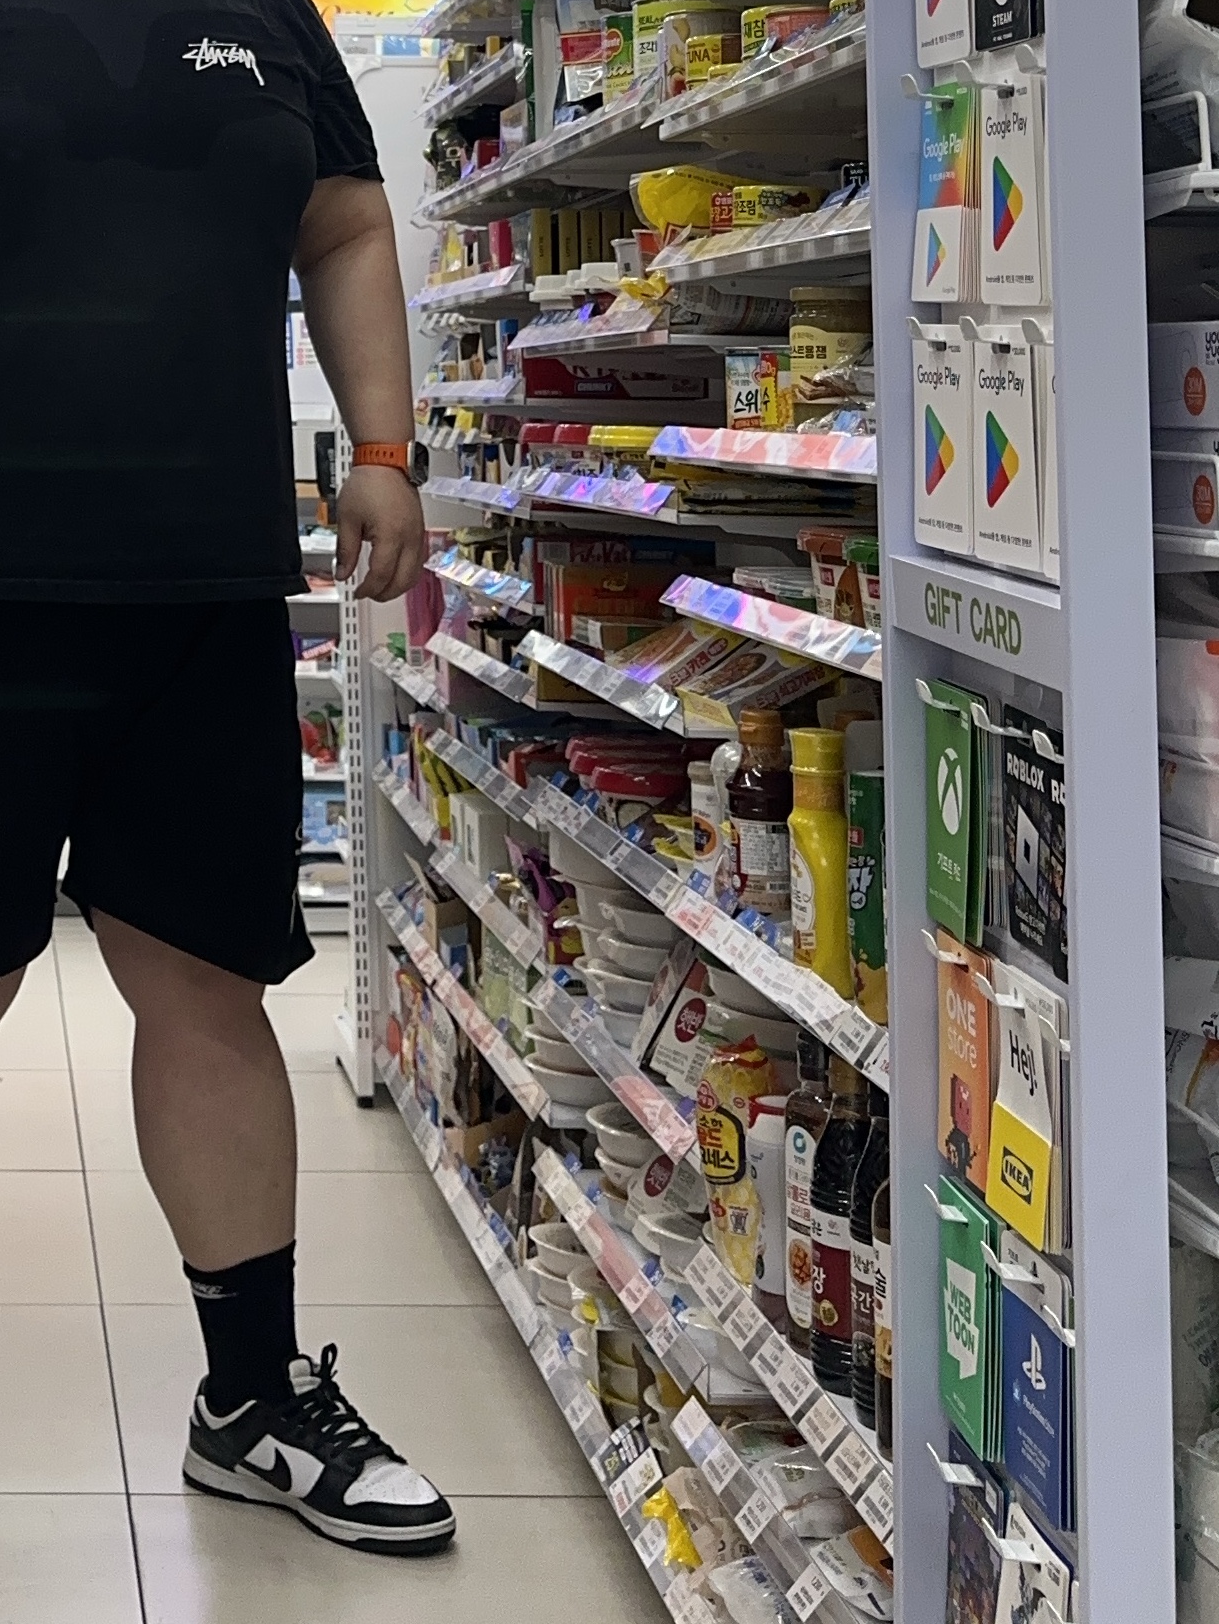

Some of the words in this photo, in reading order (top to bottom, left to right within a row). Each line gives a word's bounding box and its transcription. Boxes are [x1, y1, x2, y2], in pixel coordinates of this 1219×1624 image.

[992, 10, 1013, 28] STEAM
[922, 136, 949, 162] Google
[948, 132, 964, 156] Play
[986, 115, 1012, 140] Google
[1012, 111, 1028, 136] Play
[917, 364, 943, 390] Google
[944, 367, 961, 392] Play
[978, 368, 1006, 395] Google
[1007, 372, 1025, 397] Play
[924, 582, 963, 635] GIFT
[969, 597, 1022, 656] CARD
[1006, 751, 1046, 794] ROBLOX
[945, 987, 977, 1037] ONE
[947, 1026, 978, 1069] store
[1008, 1029, 1039, 1097] Hej!
[1003, 1158, 1032, 1194] IKEA
[949, 1280, 972, 1325] WEB
[946, 1302, 976, 1356] TOON
